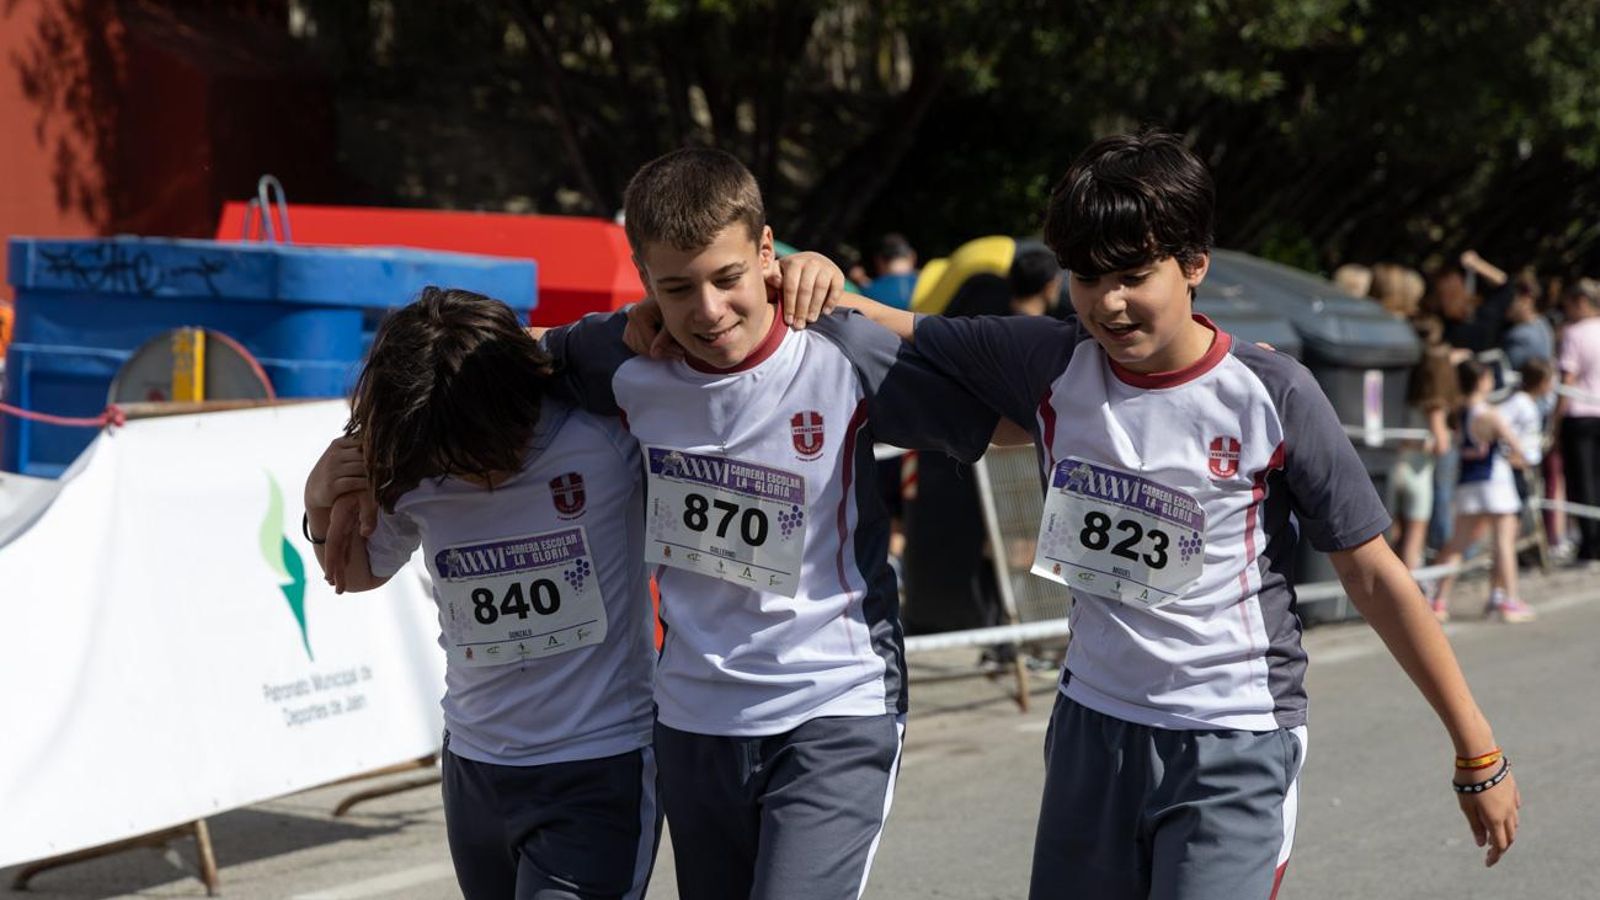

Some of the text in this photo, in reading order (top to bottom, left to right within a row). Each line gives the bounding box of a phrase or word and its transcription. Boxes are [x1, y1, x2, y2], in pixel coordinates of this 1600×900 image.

[678, 457, 801, 488] XXXVI CARRERA ESCOLAR
[736, 478, 748, 488] LA
[755, 482, 791, 498] GLORIA
[1085, 470, 1140, 503] XXXVI
[1141, 484, 1172, 503] CARRERA
[1174, 493, 1203, 516] ESCOLAR
[1145, 497, 1193, 523] LA GLORIA
[683, 493, 769, 547] 870
[456, 547, 506, 573] XXXVI
[505, 541, 540, 555] CARRERA
[541, 534, 578, 550] ESCOLAR
[513, 547, 570, 566] LA GLORIA
[1079, 511, 1170, 570] 823
[471, 578, 561, 625] 840
[262, 665, 372, 702] Patronato Municipal de
[282, 703, 328, 726] Deportes
[330, 700, 342, 714] de
